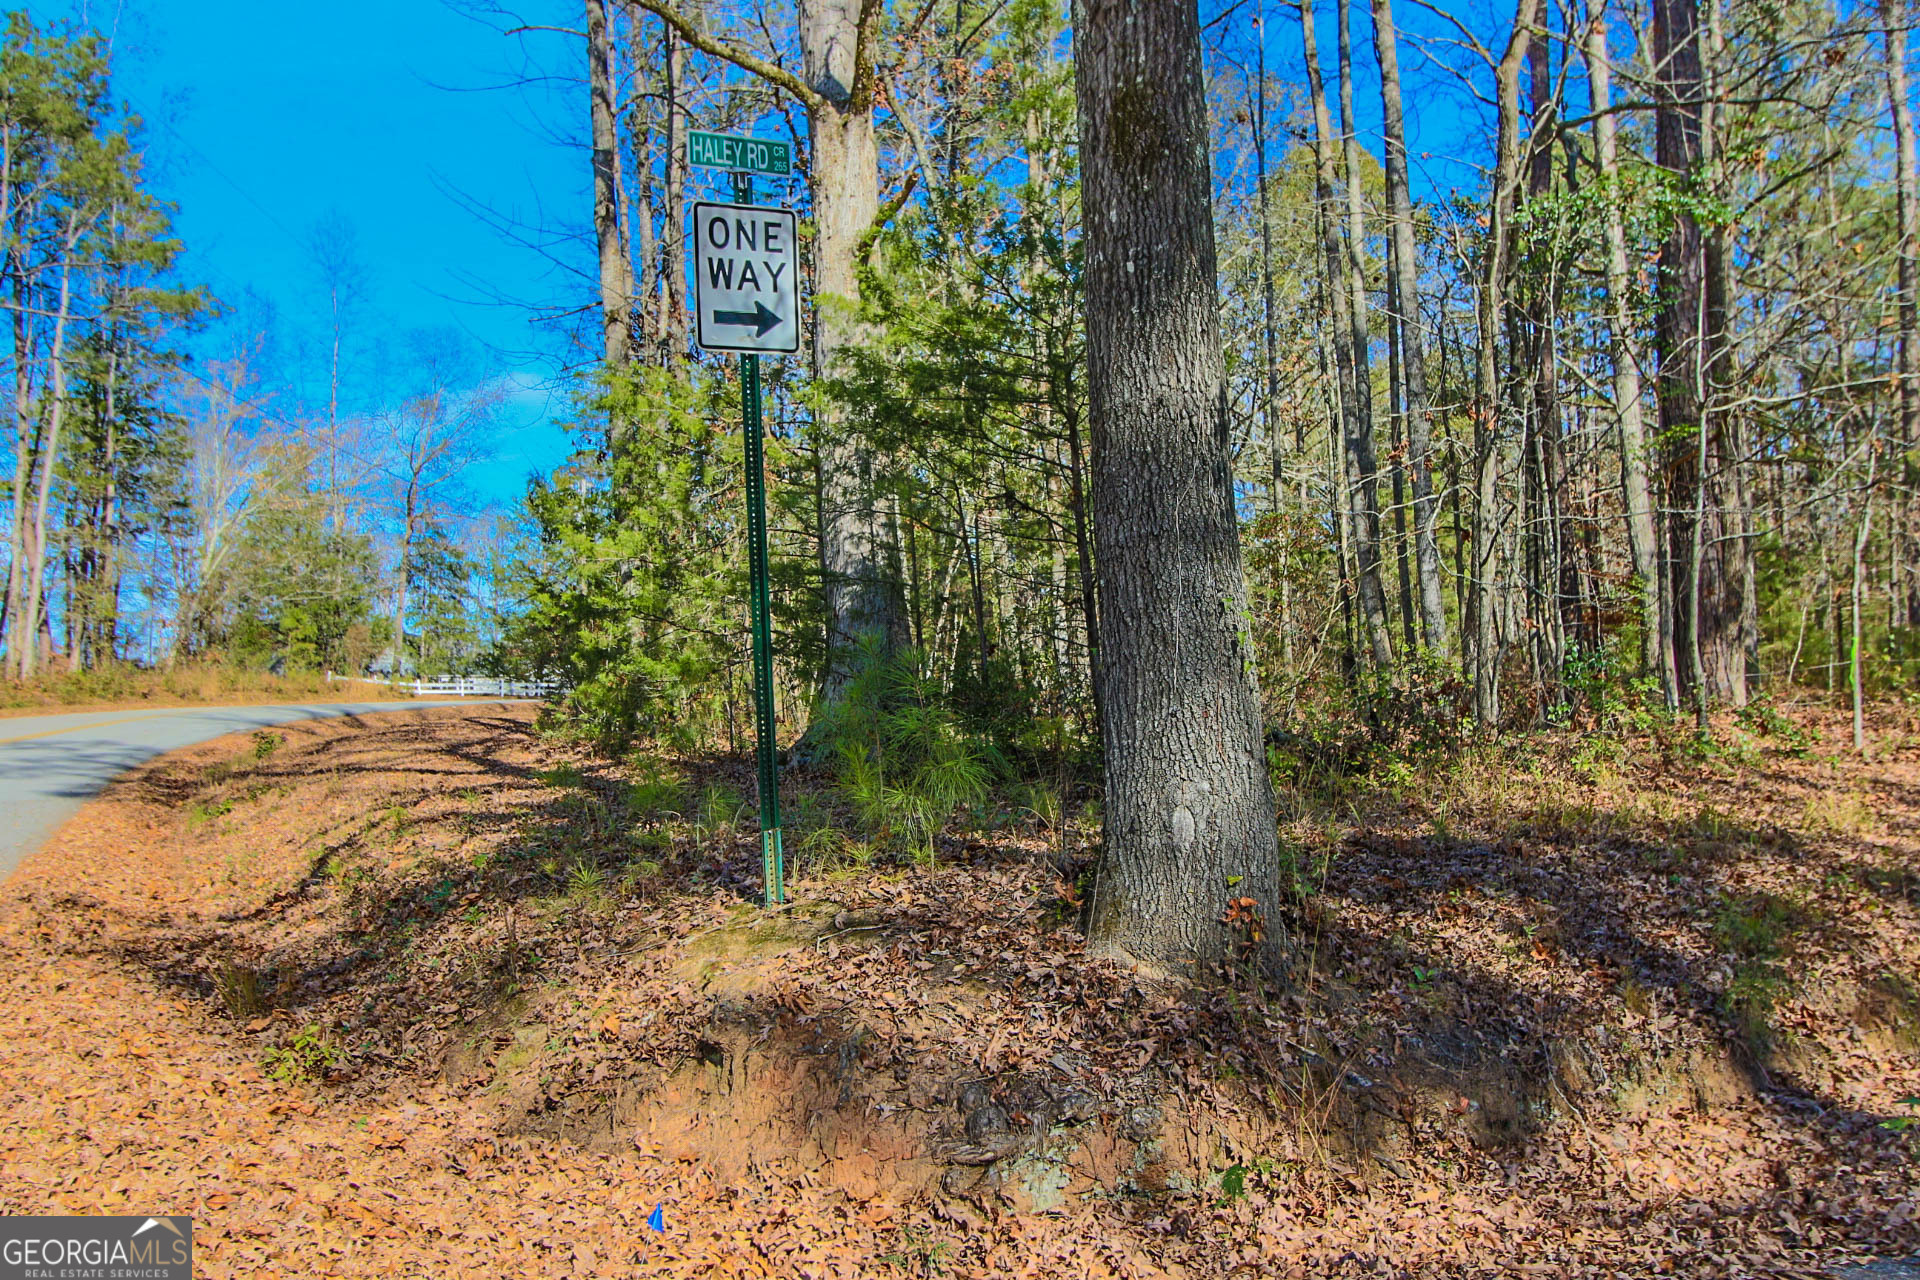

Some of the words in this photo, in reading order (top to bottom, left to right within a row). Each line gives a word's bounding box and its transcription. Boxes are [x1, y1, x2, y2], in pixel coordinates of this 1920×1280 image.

[692, 135, 742, 167] HALEY
[747, 142, 769, 169] RD
[773, 146, 785, 158] CR
[774, 161, 788, 172] 265
[708, 216, 783, 253] ONE
[707, 257, 786, 293] WAY
